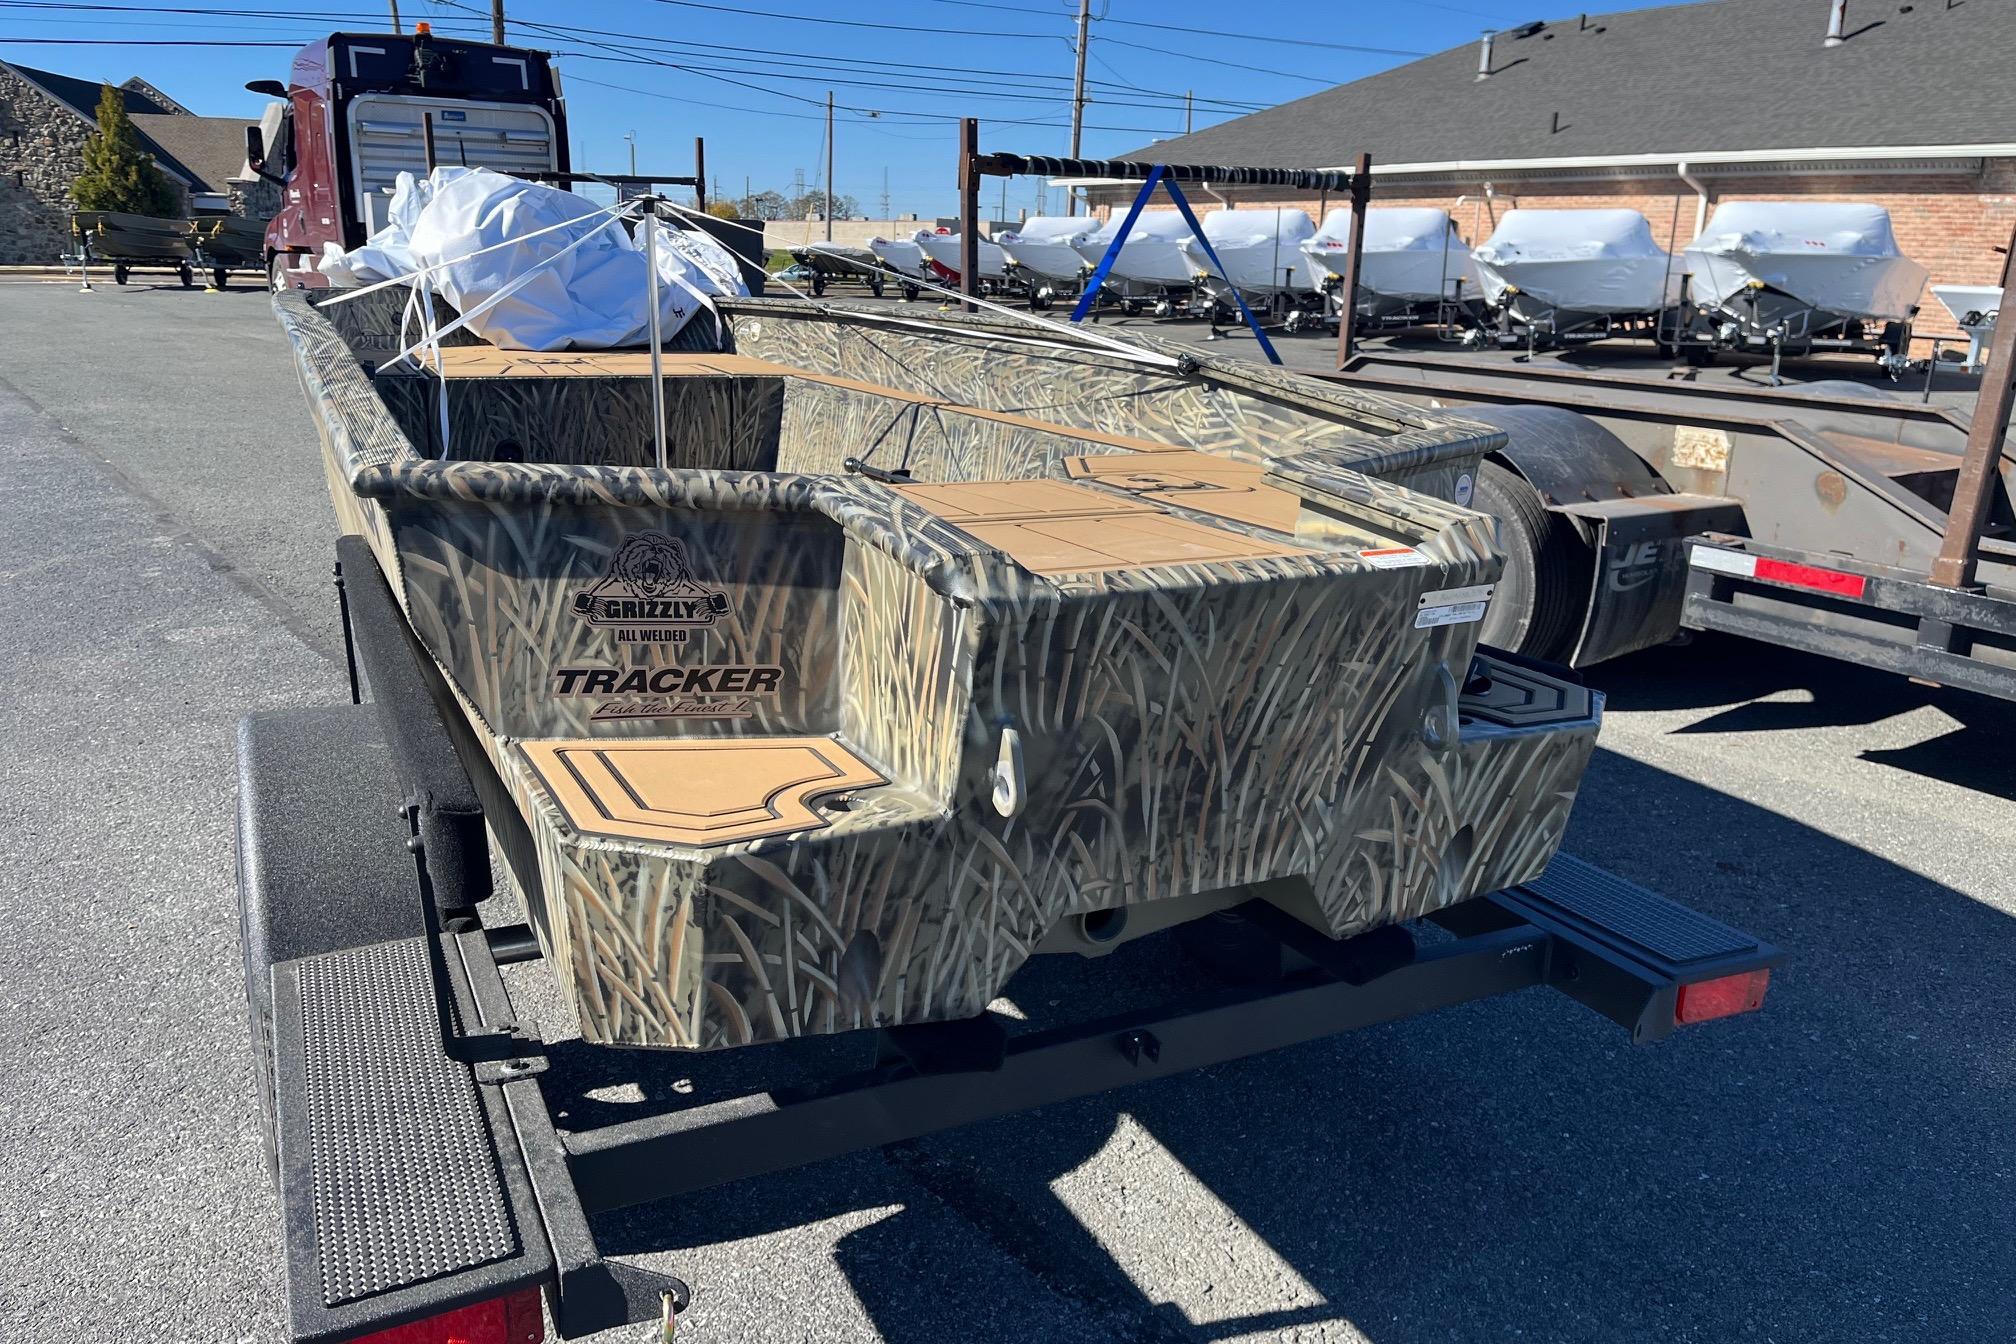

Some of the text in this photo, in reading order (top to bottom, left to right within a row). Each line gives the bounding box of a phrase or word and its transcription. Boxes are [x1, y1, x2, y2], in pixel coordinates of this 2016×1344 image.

[606, 600, 696, 619] GRIZZLY
[618, 629, 687, 642] ALL WELDED
[556, 668, 782, 694] TRACKER
[596, 702, 637, 715] Fish
[640, 703, 669, 714] the
